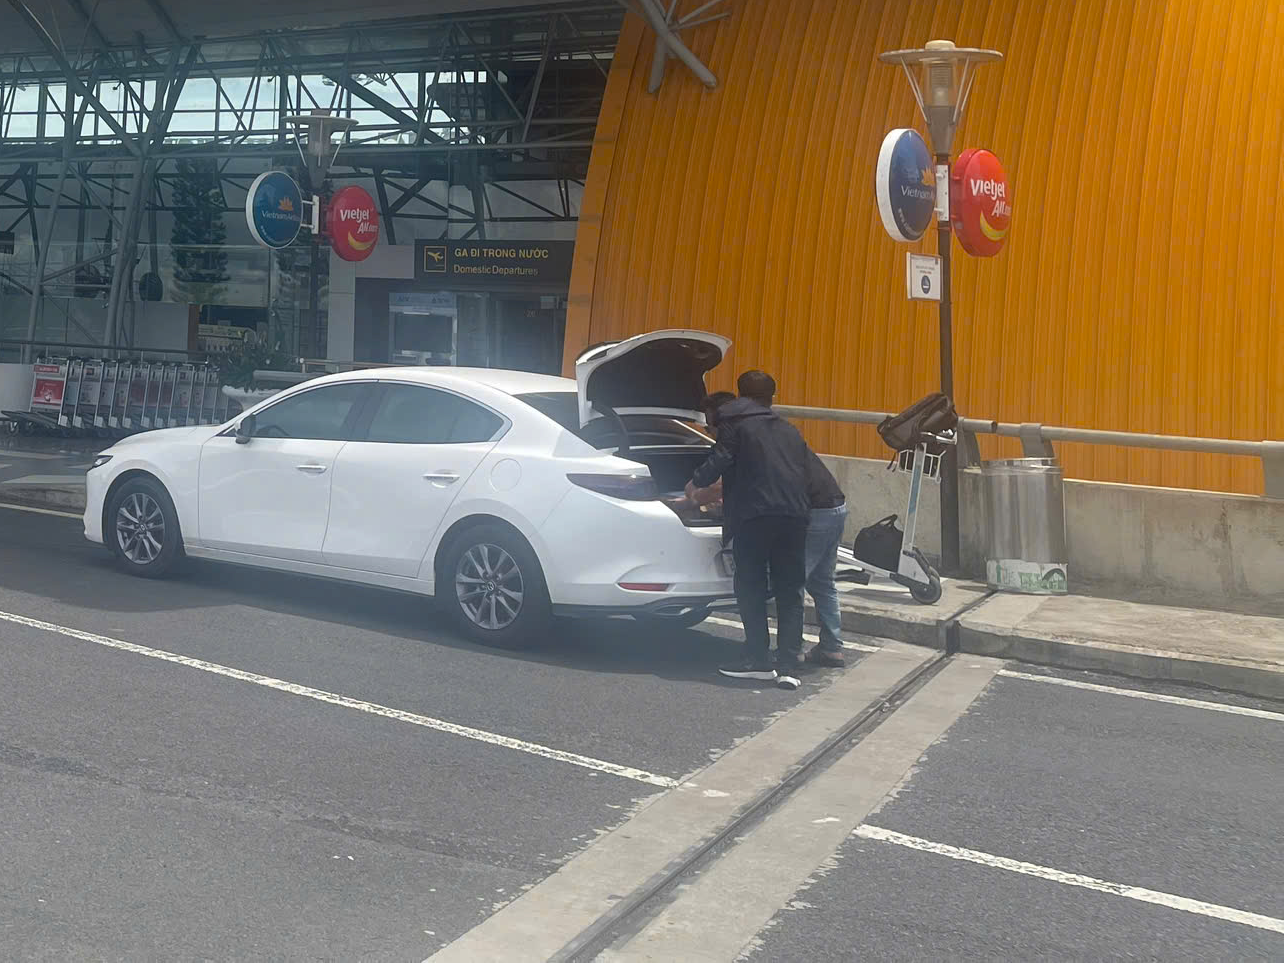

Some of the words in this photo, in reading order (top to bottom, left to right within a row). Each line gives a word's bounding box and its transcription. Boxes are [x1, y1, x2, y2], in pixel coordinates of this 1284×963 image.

[454, 247, 469, 257] GA
[470, 248, 480, 257] ĐI
[482, 248, 517, 258] TRONG
[518, 245, 549, 259] NƯỚC
[453, 264, 492, 275] Domestic
[492, 265, 539, 277] Departures
